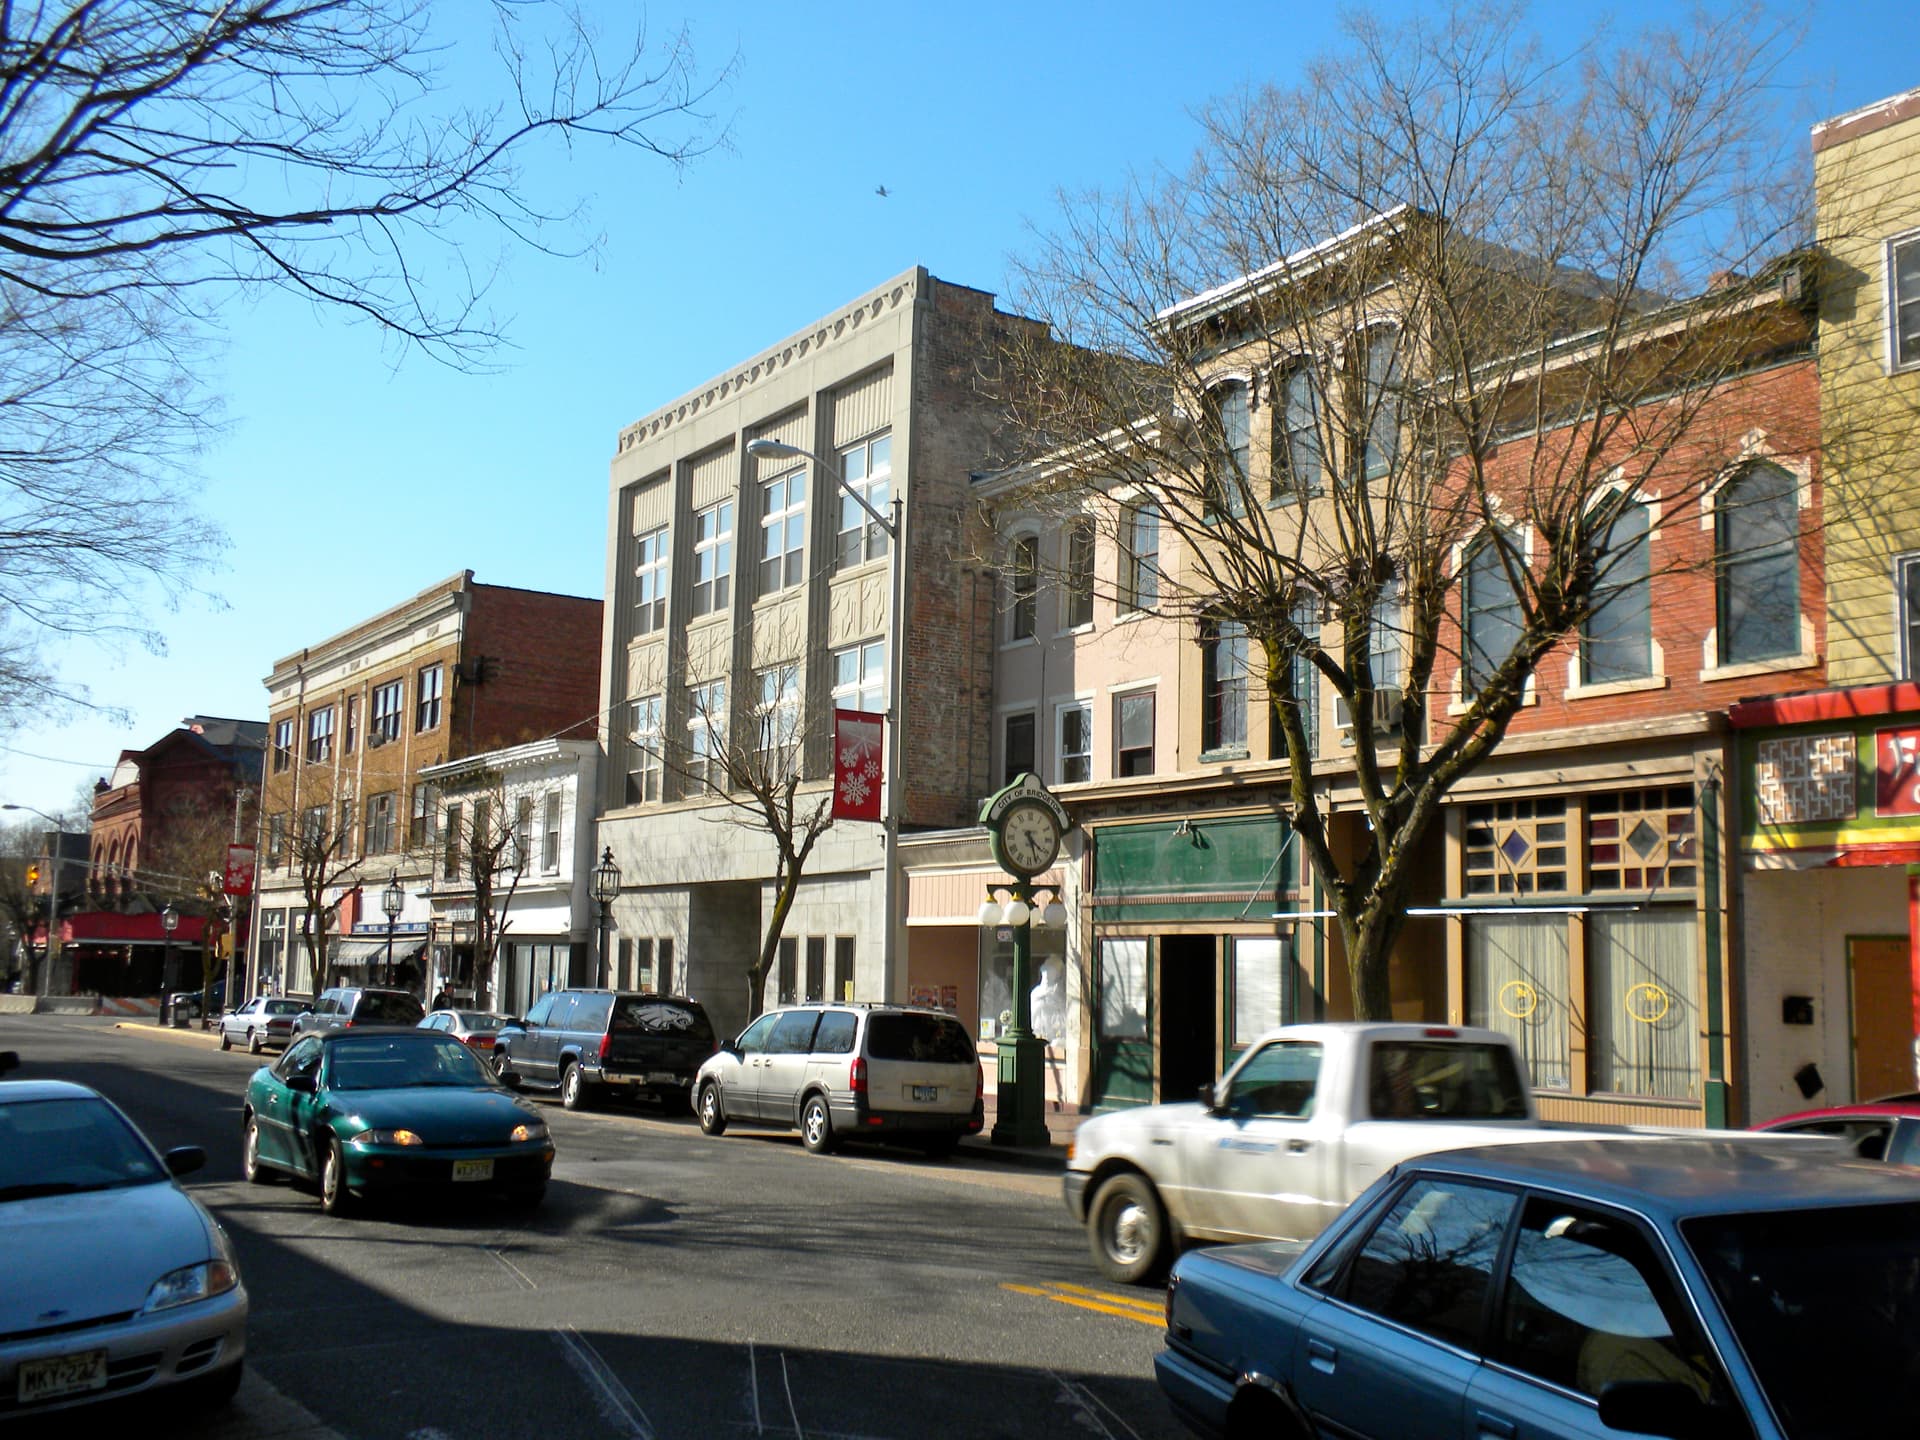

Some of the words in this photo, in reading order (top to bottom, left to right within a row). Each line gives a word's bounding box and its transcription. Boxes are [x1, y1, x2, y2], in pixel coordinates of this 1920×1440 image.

[998, 794, 1012, 809] CITY
[1014, 789, 1023, 798] OF
[1026, 789, 1062, 813] BRIDGETON
